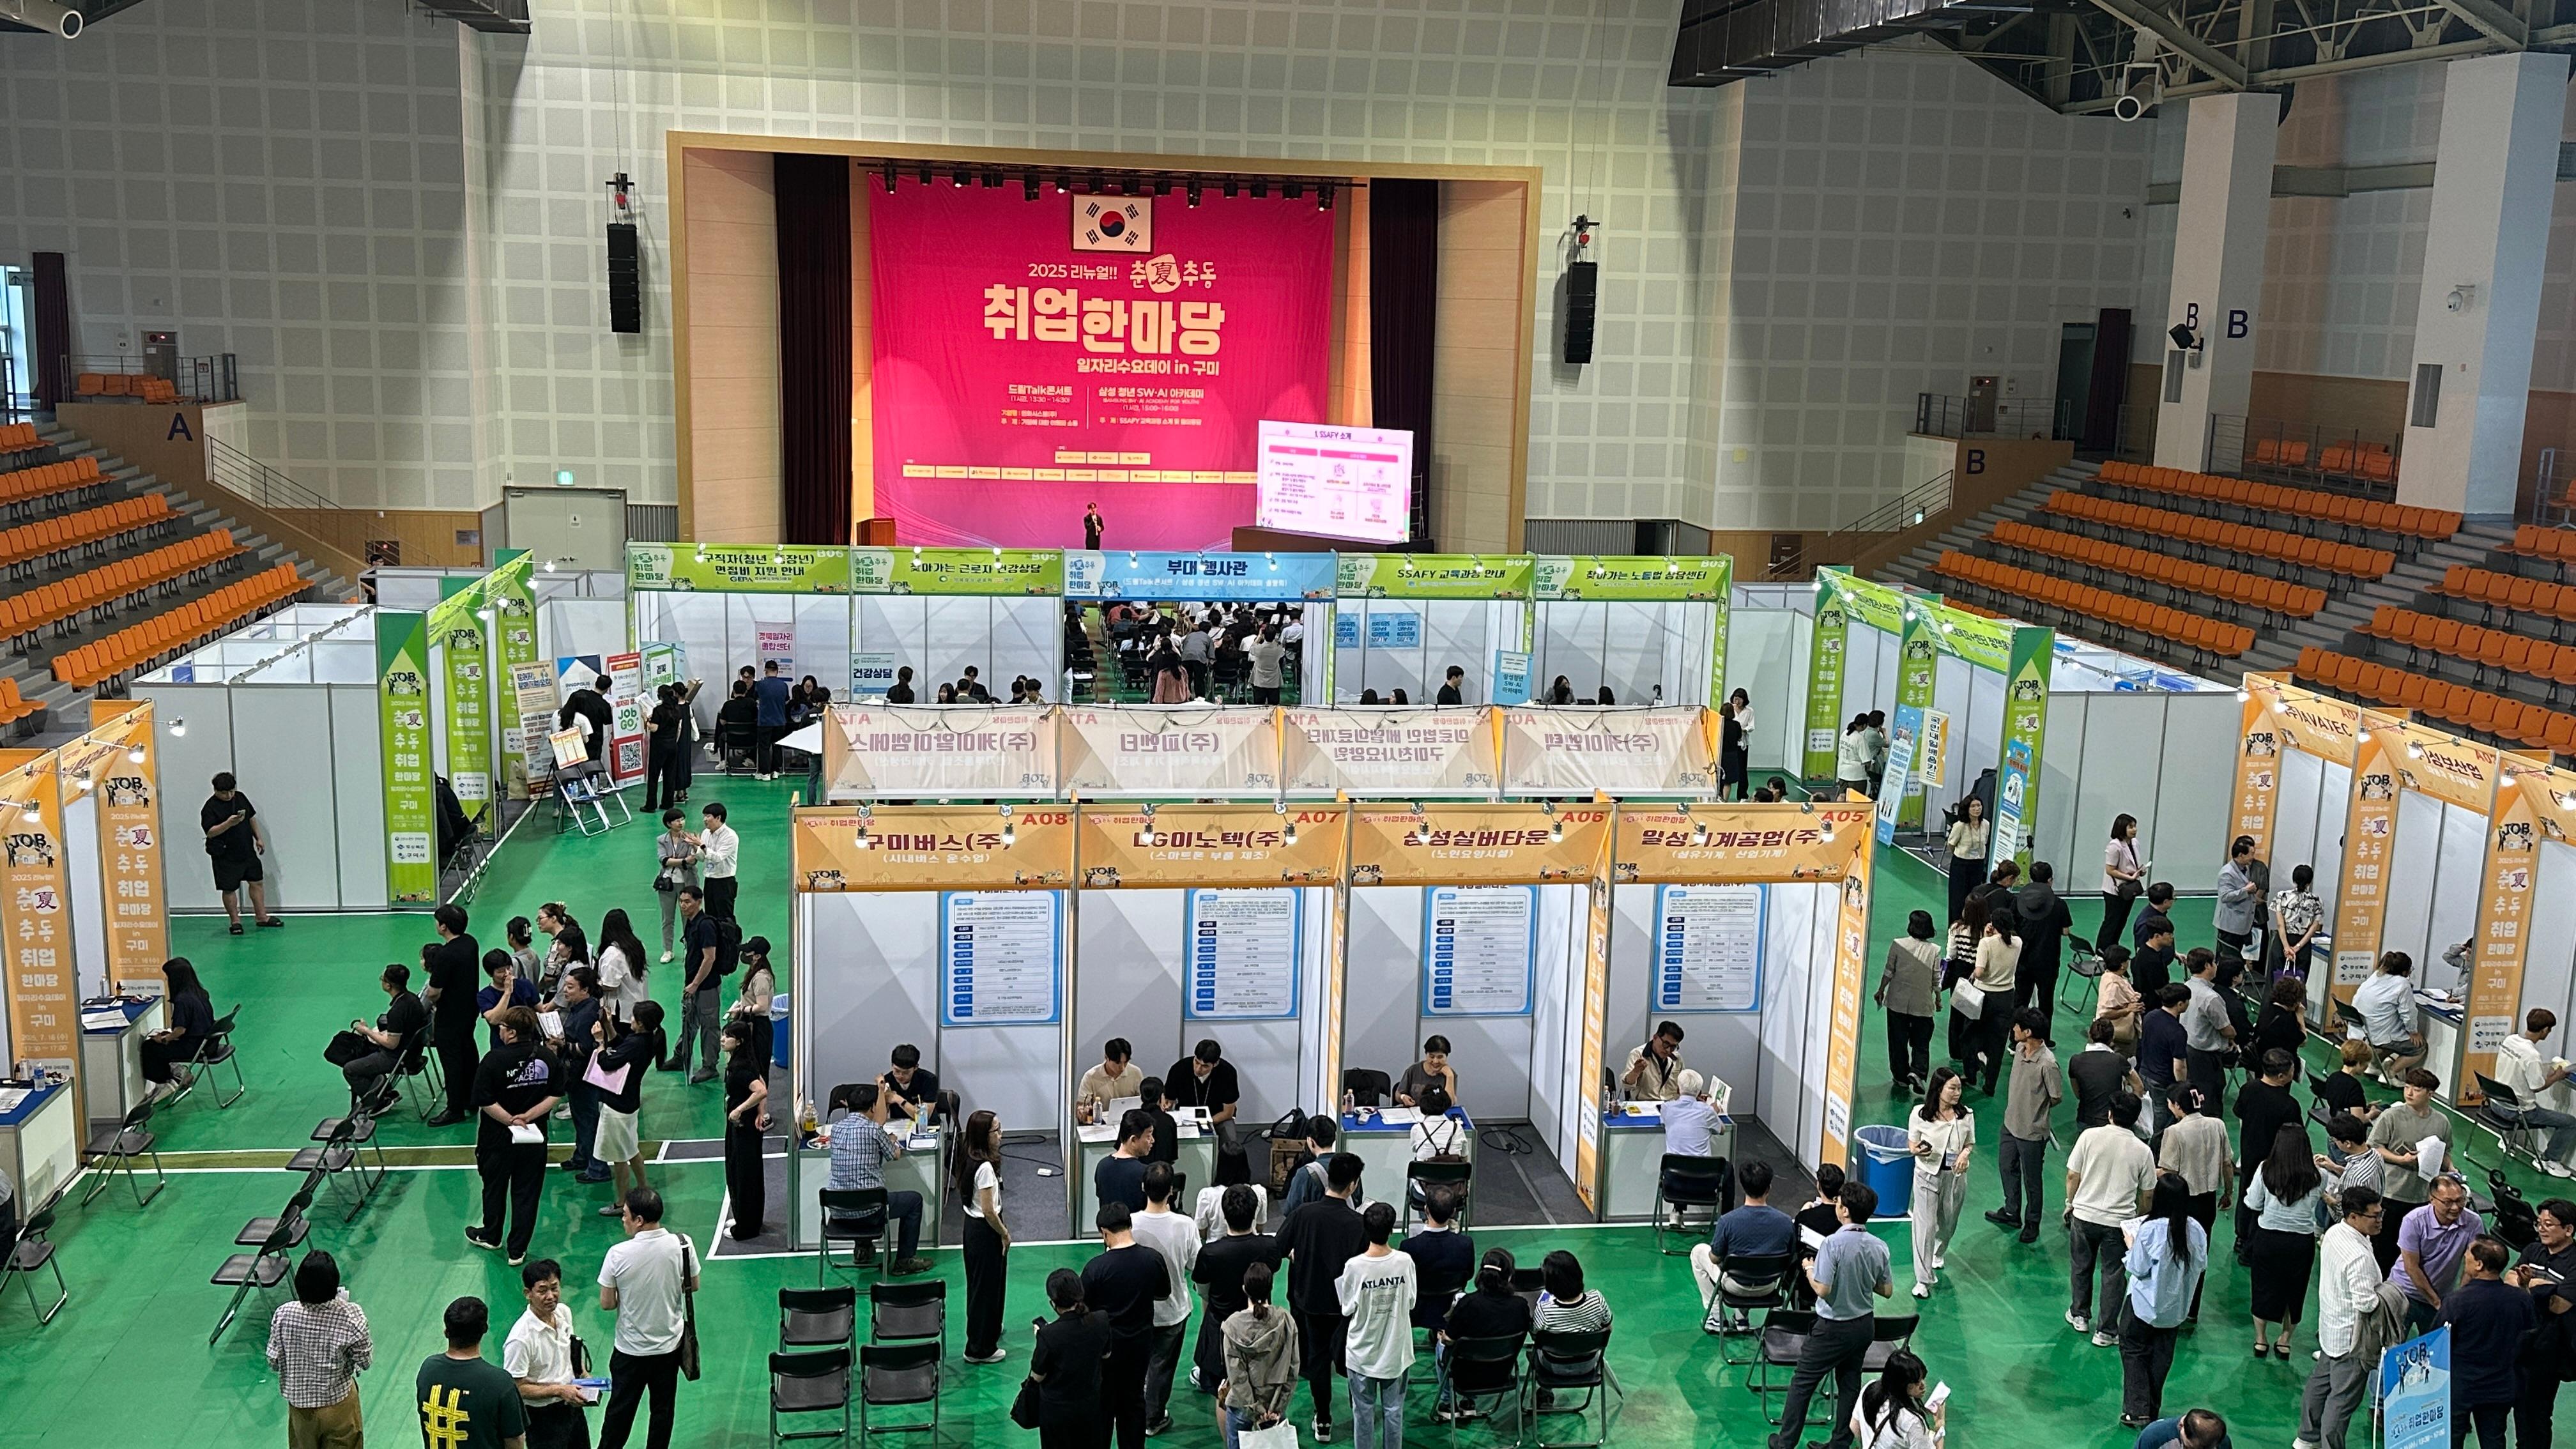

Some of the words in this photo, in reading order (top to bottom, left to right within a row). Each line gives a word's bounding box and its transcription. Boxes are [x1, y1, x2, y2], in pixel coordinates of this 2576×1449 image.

[1028, 263, 1068, 278] 2025
[1071, 264, 1117, 280] 리뉴얼!!
[984, 284, 1226, 355] 취업한마당
[2186, 303, 2199, 331] B
[2227, 309, 2248, 338] B
[1077, 358, 1171, 374] 일자리수요데이
[1174, 359, 1189, 374] in
[1192, 360, 1220, 376] 구미
[1008, 385, 1073, 395] 드림Talk콘서트
[1098, 387, 1116, 397] 삼성
[1118, 388, 1136, 397] 청년
[1170, 388, 1204, 399] 아카데미
[167, 413, 193, 442] A
[1966, 449, 1985, 474] B
[634, 564, 654, 572] 취업
[715, 565, 751, 576] 면접비
[755, 567, 778, 576] 지원
[781, 567, 805, 576] 안내
[959, 562, 992, 574] 근로자
[997, 564, 1043, 574] 건강상담
[1167, 560, 1198, 575] 부대
[1203, 560, 1248, 576] 행사관
[1397, 569, 1436, 578] SSAFY
[1439, 570, 1481, 579] 교육과정
[1484, 569, 1506, 578] 안내
[635, 572, 664, 581] 한마당
[1586, 570, 1629, 580] 찾아가는
[1630, 571, 1662, 581] 노동법
[1665, 571, 1707, 581] 상담센터
[454, 629, 475, 638] JOB
[1911, 640, 1929, 649] JOB
[391, 672, 417, 683] JOB
[853, 668, 893, 678] 건강상담
[2018, 680, 2039, 689] JOB
[2251, 732, 2273, 743] JOB
[394, 753, 420, 767] 취업
[111, 777, 142, 790] JOB
[2366, 774, 2391, 786] JOB
[399, 800, 418, 810] 구미
[830, 817, 875, 827] 취업한마당
[1022, 813, 1068, 825] A08
[1295, 811, 1342, 824] A07
[1561, 811, 1605, 823] A06
[1645, 815, 1687, 824] 취업한마당
[1820, 811, 1865, 822] A05
[2504, 822, 2530, 835] JOB
[10, 833, 47, 849] JOB
[1403, 830, 1549, 847] 삼성실버타운
[882, 853, 940, 864] (시내버스
[947, 853, 991, 864] 운수업)
[1149, 850, 1206, 861] (스마트폰
[1211, 850, 1234, 861] 부품
[1239, 850, 1270, 861] 제조)
[1431, 848, 1514, 859] (노인요양시설)
[1735, 849, 1788, 859] 산업기계)
[118, 854, 149, 876] 추동
[1090, 866, 1117, 875] JOB
[1354, 864, 1381, 873] JOB
[812, 870, 841, 878] JOB
[2354, 864, 2379, 880] 취업
[118, 879, 150, 898] 취업
[118, 903, 151, 916] 한마당
[2350, 916, 2370, 926] 구미
[20, 918, 55, 943] 추동
[2490, 921, 2518, 938] 취업
[126, 939, 149, 951] 구미
[2487, 942, 2516, 955] 한마당
[20, 947, 56, 967] 취업
[21, 974, 59, 987] 한마당
[2487, 977, 2506, 988] 구미
[30, 1013, 56, 1027] 구미
[1361, 1275, 1406, 1291] ATLANTA
[2402, 1342, 2428, 1368] JOB
